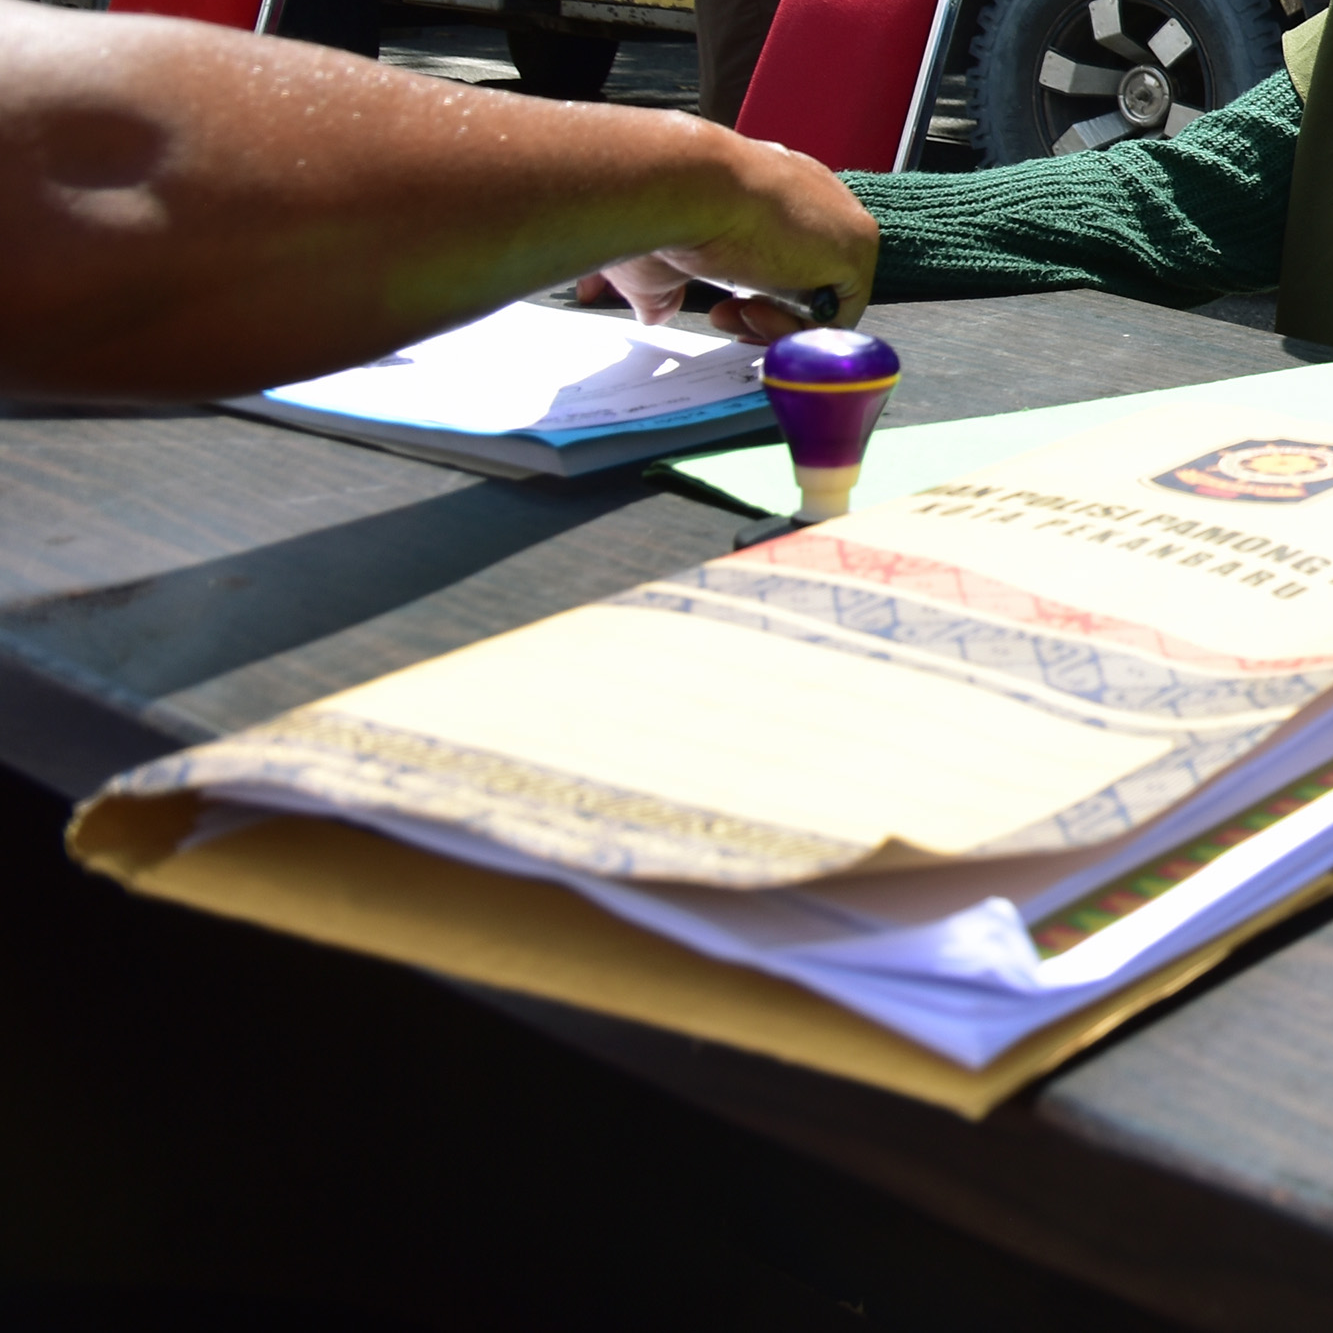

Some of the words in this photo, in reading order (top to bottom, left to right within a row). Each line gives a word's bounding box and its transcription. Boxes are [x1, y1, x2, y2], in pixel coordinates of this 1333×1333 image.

[912, 502, 1025, 524] KOTA
[1032, 518, 1310, 600] PEKANBARU
[997, 490, 1143, 522] POLISI
[1136, 514, 1333, 576] PAMONG
